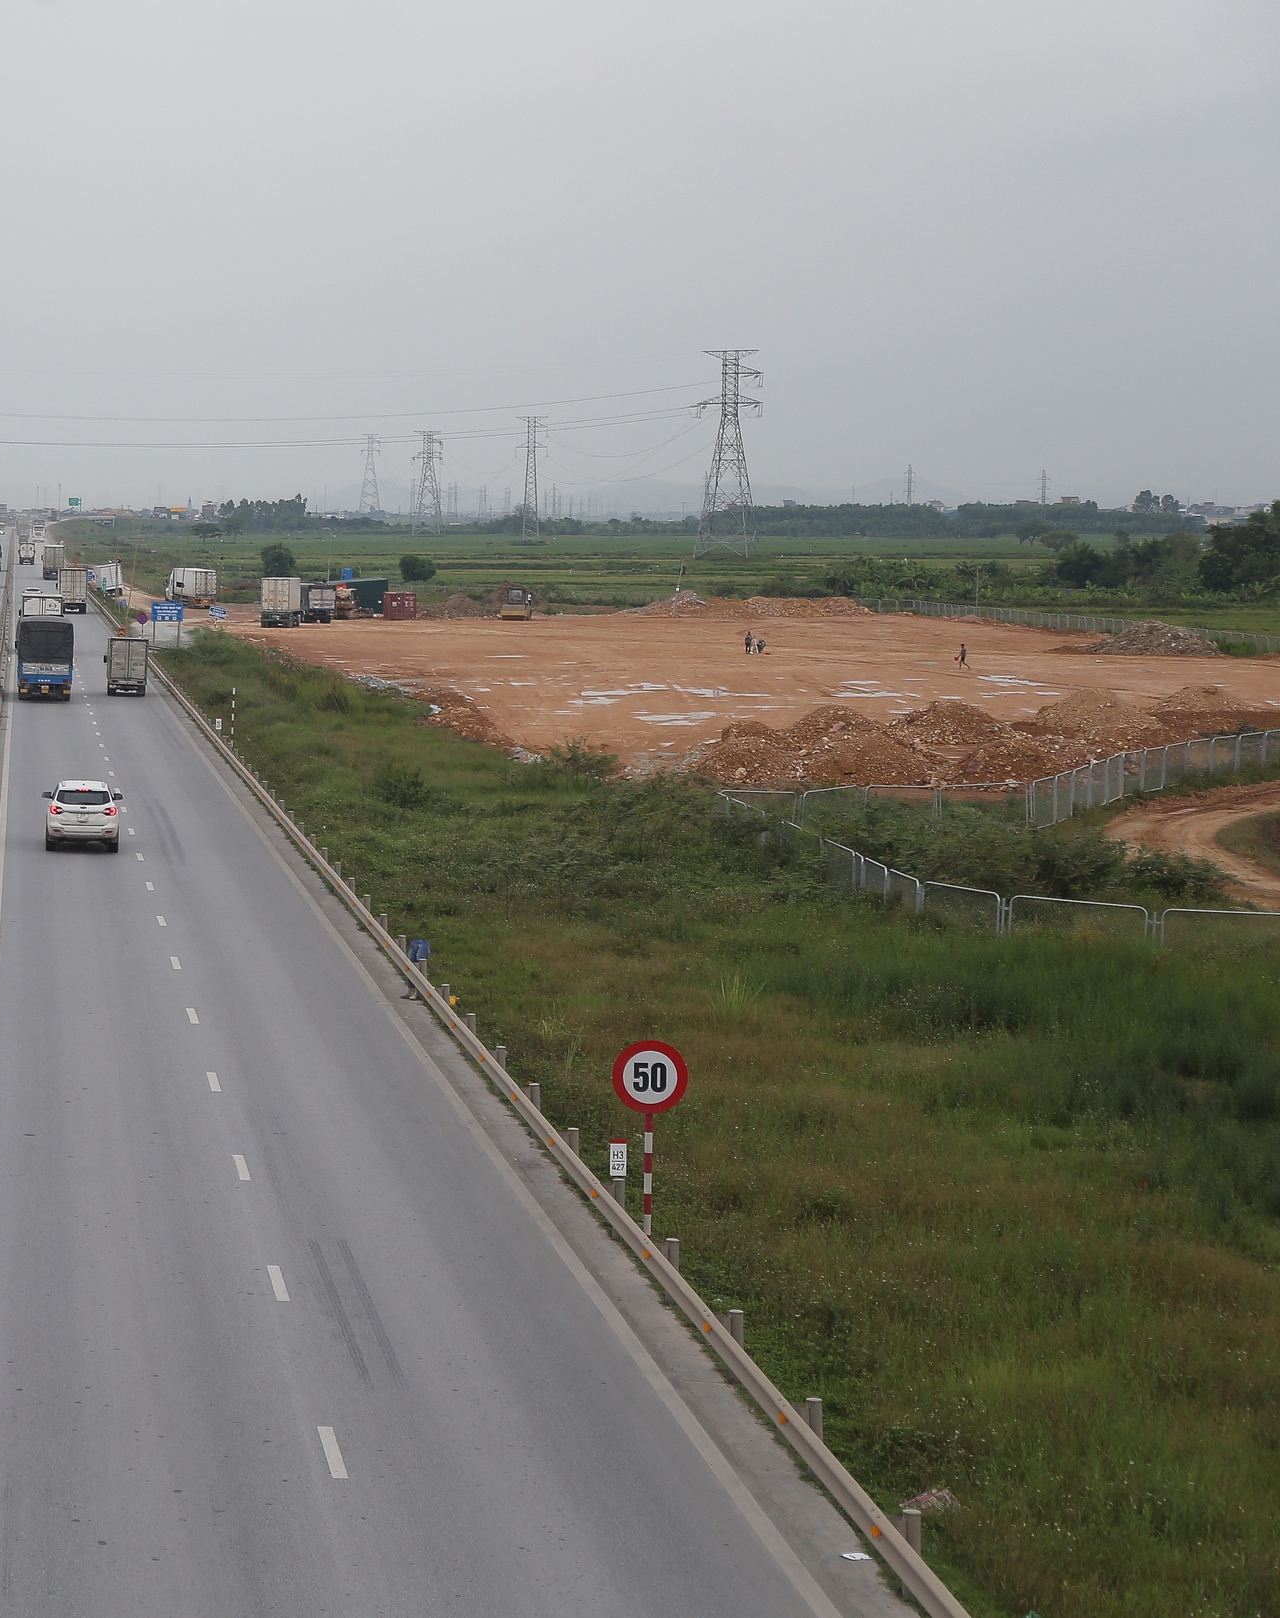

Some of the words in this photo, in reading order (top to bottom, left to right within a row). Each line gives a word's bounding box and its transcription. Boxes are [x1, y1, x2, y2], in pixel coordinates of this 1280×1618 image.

[632, 1062, 667, 1093] 50
[612, 1150, 624, 1160] H3
[611, 1163, 625, 1171] 427
